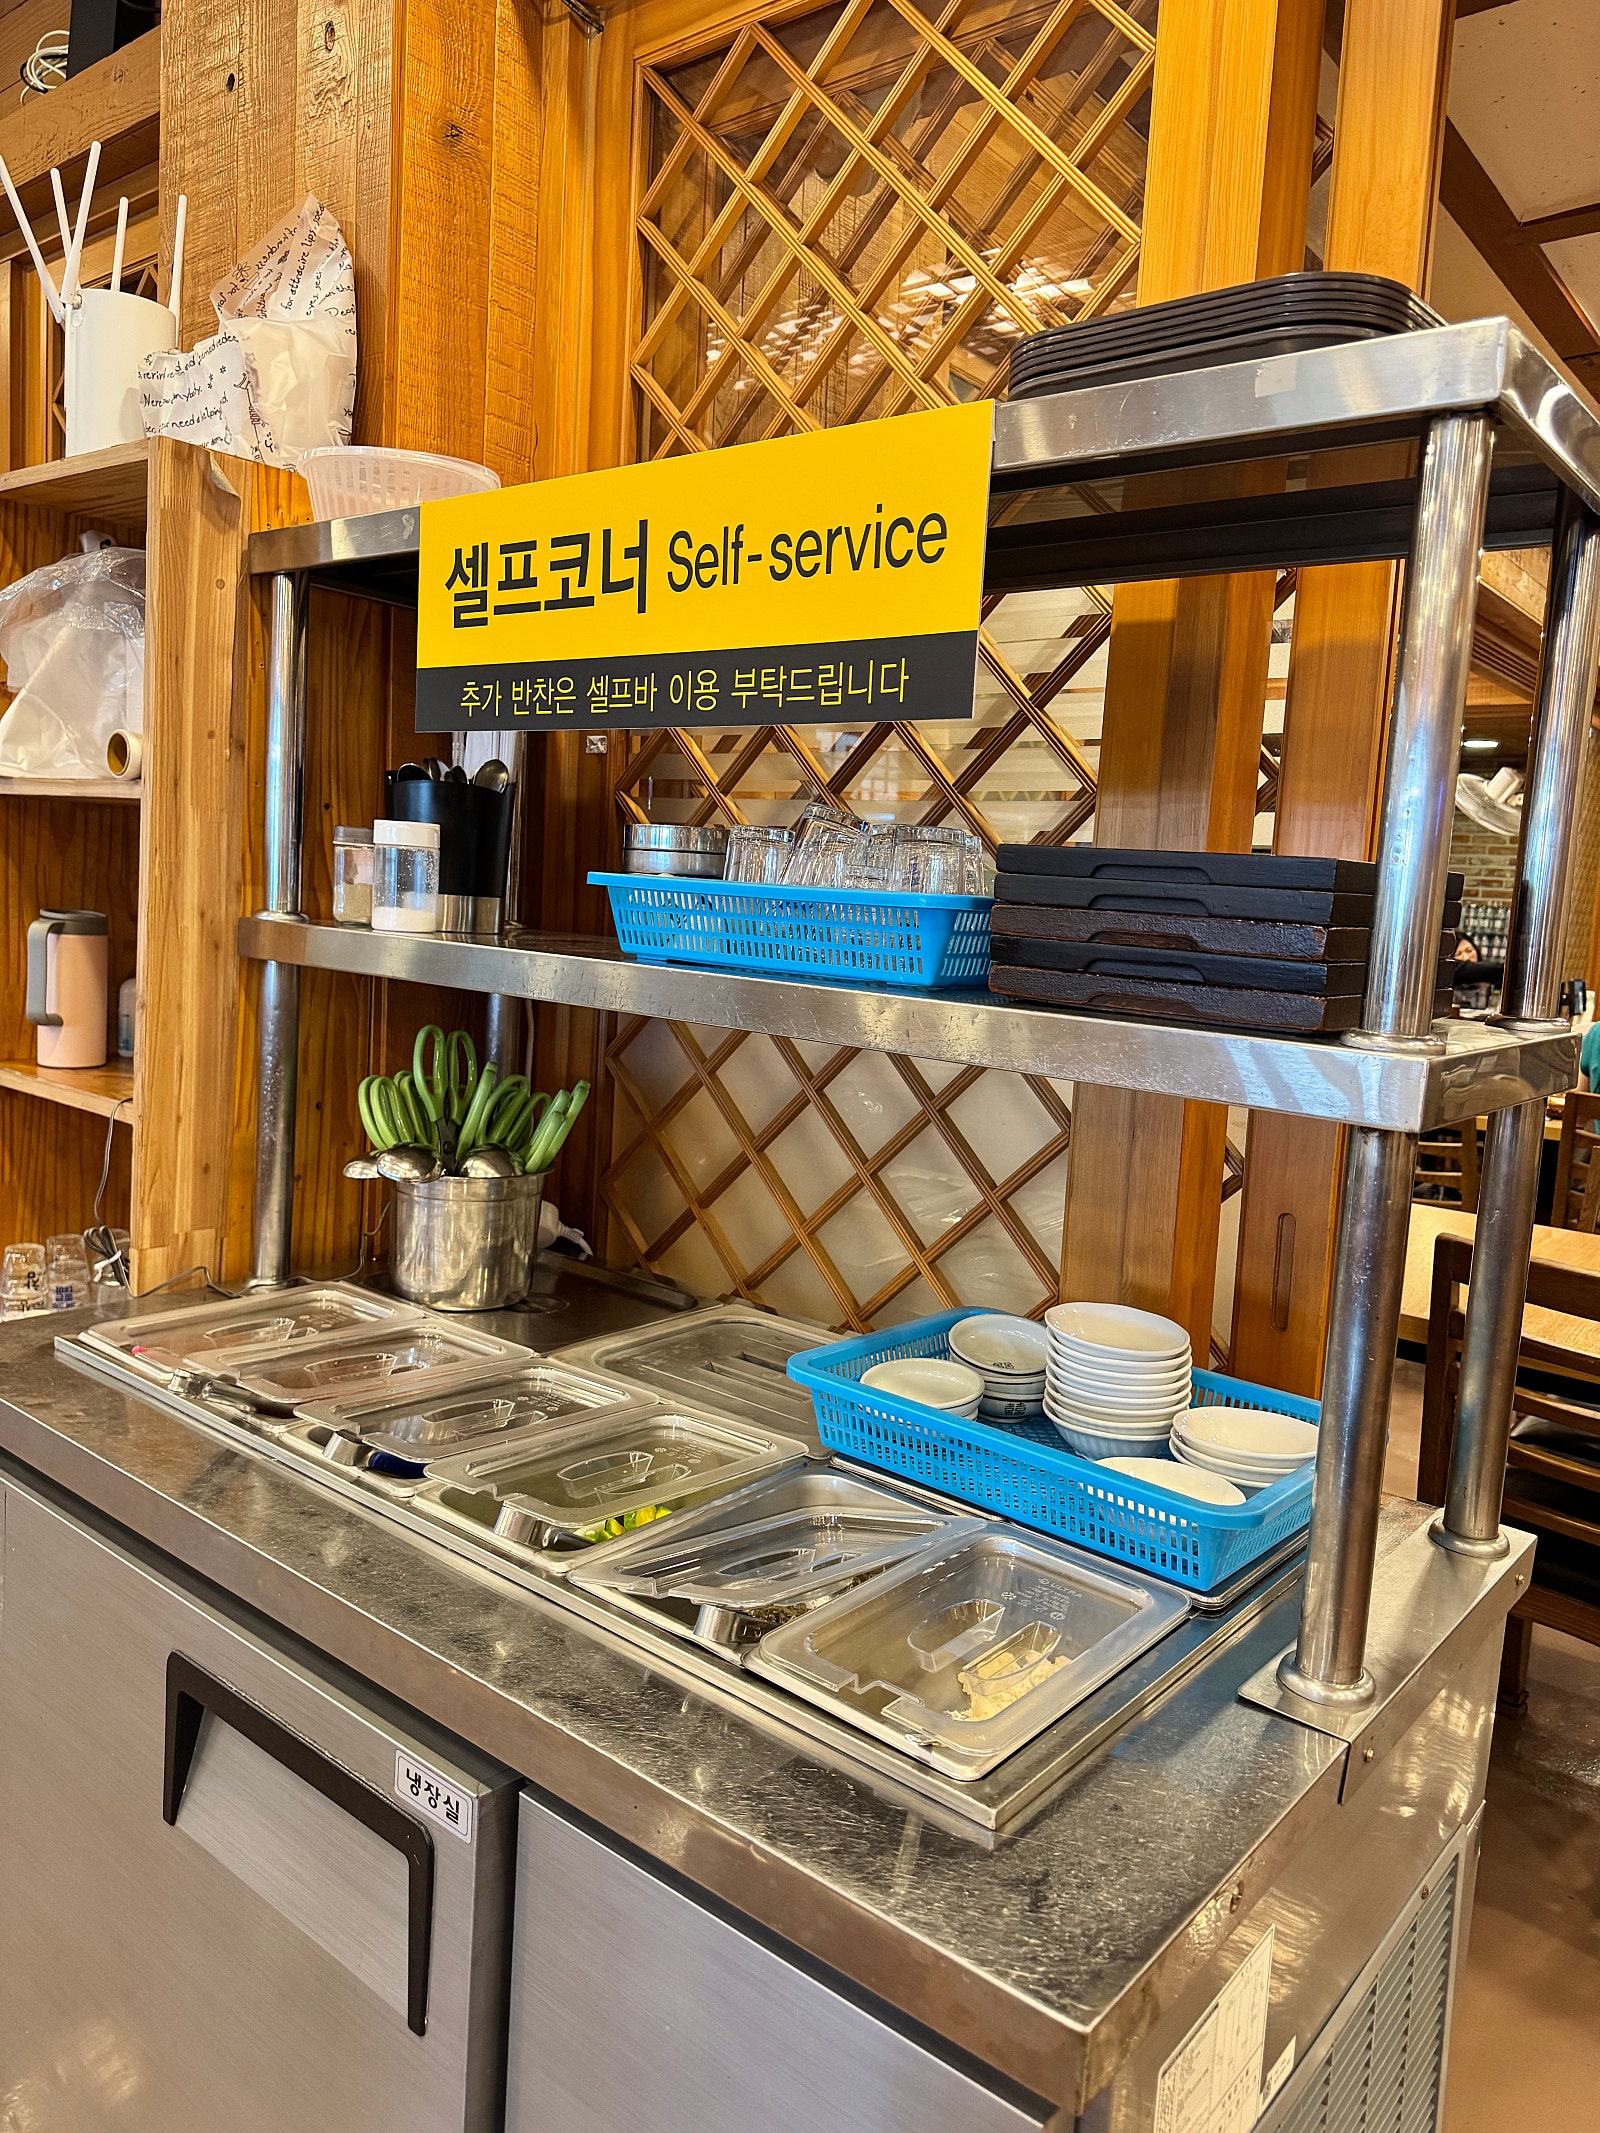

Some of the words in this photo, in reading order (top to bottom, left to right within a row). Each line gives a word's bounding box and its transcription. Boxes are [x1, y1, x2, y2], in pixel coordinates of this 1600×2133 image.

[280, 298, 294, 311] for
[445, 518, 650, 629] 셀프코너
[667, 503, 948, 593] Self-service
[460, 679, 503, 718] 추가
[511, 676, 576, 716] 반찬은
[586, 673, 659, 713] 셀프바
[669, 668, 721, 711] 이용
[731, 657, 911, 709] 부탁드립니다
[406, 1767, 460, 1826] 냉장실
